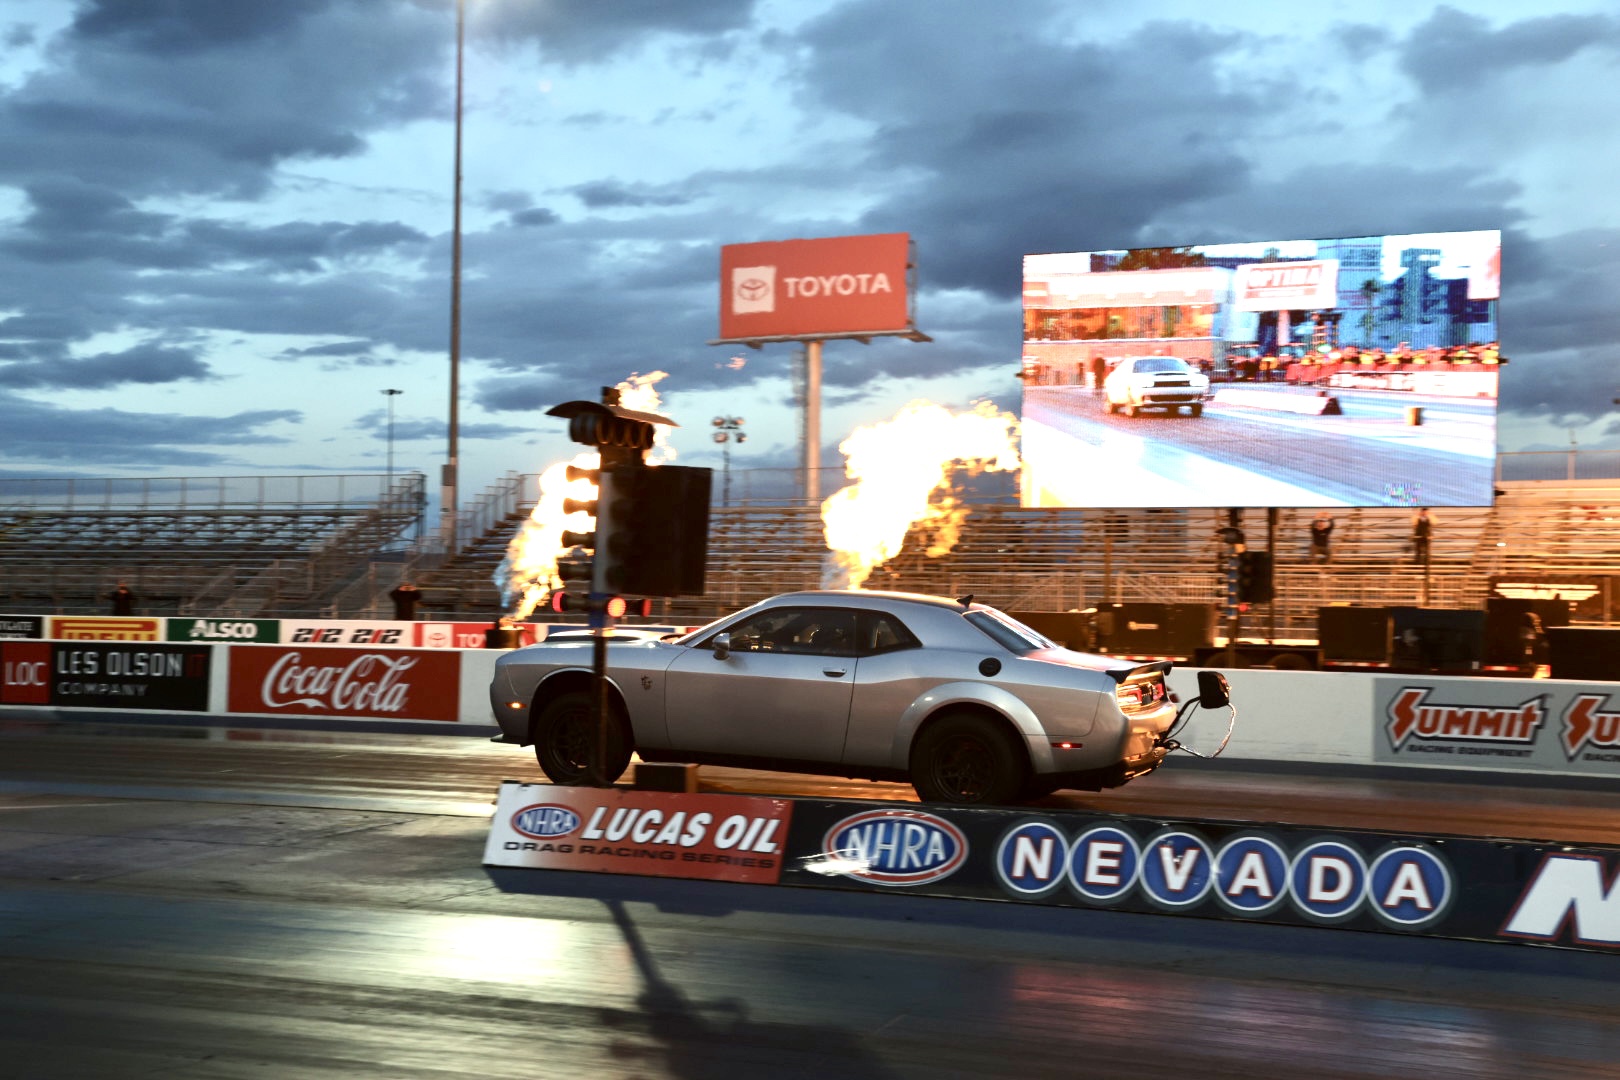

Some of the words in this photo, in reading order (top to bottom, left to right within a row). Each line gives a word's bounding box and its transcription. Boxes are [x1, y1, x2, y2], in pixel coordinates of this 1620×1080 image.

[784, 273, 891, 298] TOYOTA
[190, 620, 257, 638] ALSCO
[5, 662, 46, 686] LOC
[57, 651, 99, 674] LES
[106, 652, 183, 676] OLSON
[57, 682, 148, 695] COMPANY
[262, 652, 420, 711] Coca-Cola
[1407, 745, 1454, 754] RACING
[1457, 747, 1534, 757] EQUIPMENT
[517, 807, 580, 836] NHRA
[580, 806, 713, 847] LUCAS
[713, 814, 781, 854] OIL
[504, 841, 575, 853] DRAG
[579, 844, 678, 860] RACING
[680, 852, 776, 868] SERIES
[848, 822, 946, 868] NHRA
[1012, 836, 1433, 910] NEVADA
